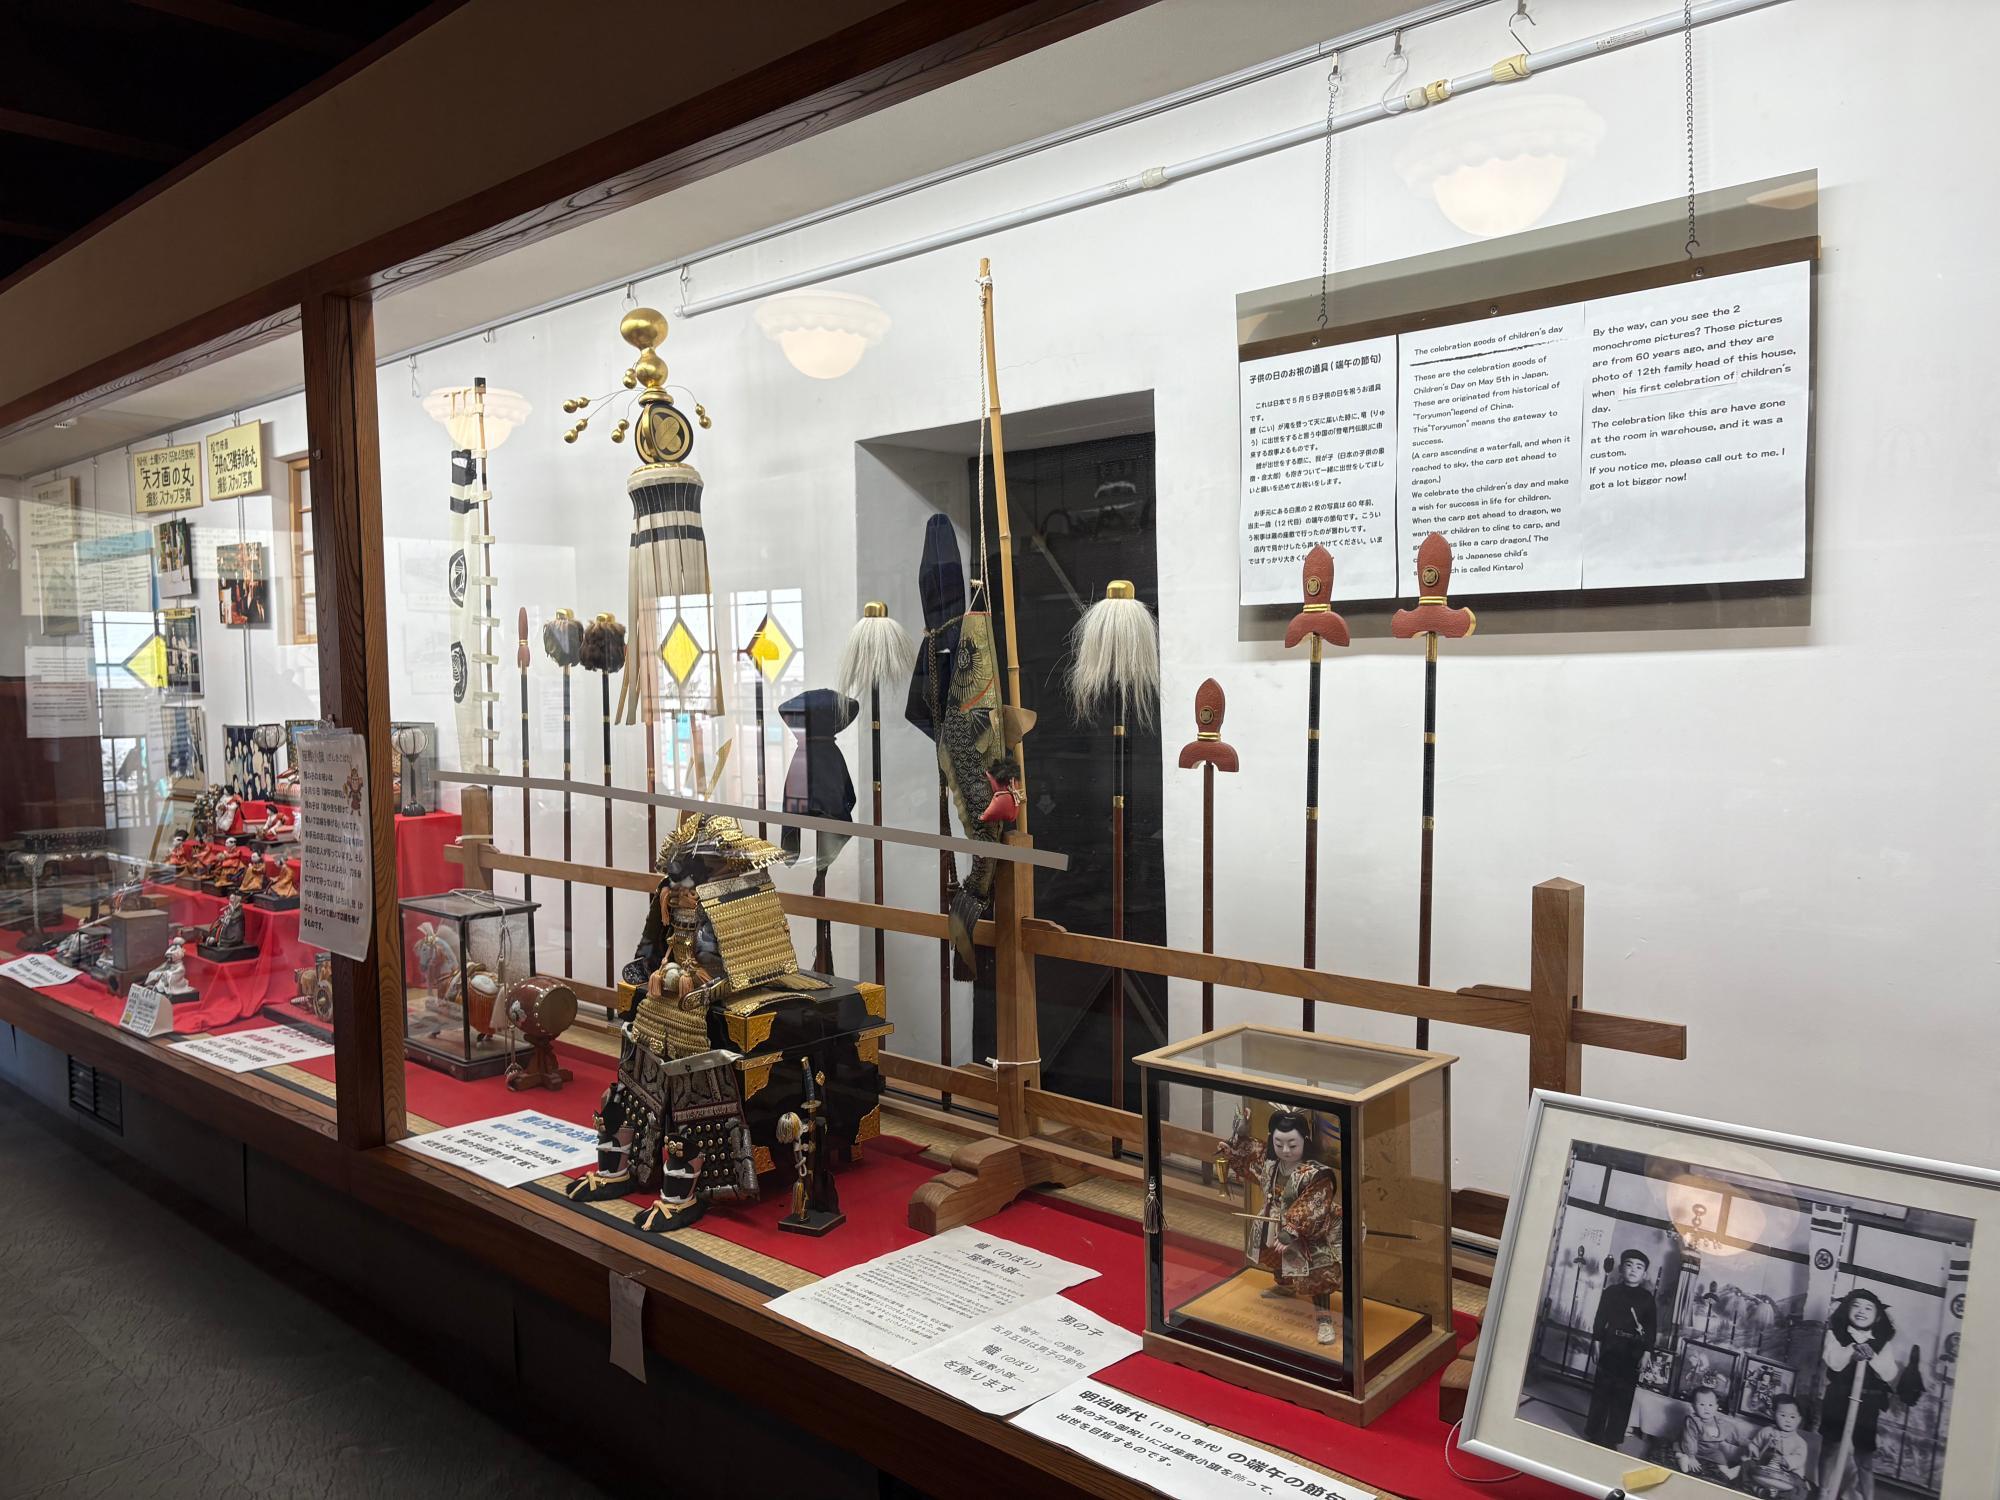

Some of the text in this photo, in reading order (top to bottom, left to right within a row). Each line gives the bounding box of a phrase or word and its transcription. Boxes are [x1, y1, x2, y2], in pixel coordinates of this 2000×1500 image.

[1592, 304, 1740, 336] By the way, can you see the 2
[1414, 348, 1428, 356] The
[1429, 341, 1471, 353] celebration
[1473, 336, 1496, 347] goods
[1497, 334, 1506, 342] of
[1548, 326, 1563, 334] day
[1592, 337, 1652, 352] monochrome
[1654, 326, 1701, 343] pictures?
[1738, 316, 1782, 330] pictures
[1592, 334, 1774, 368] are from 60 years ago, and they are
[1414, 374, 1436, 382] These
[1452, 368, 1466, 376] the
[1467, 362, 1510, 374] celebration
[1512, 357, 1536, 368] goods
[1537, 355, 1547, 363] of
[1592, 348, 1796, 384] photo of 12th family head of this house,
[1412, 400, 1436, 408] These
[1451, 391, 1490, 402] originated
[1511, 382, 1549, 394] historical
[1550, 380, 1560, 389] of
[1450, 382, 1465, 390] Day
[1478, 378, 1494, 386] May
[1496, 375, 1511, 383] 5th
[1521, 371, 1549, 380] Japan.
[1591, 389, 1615, 398] when
[1622, 386, 1637, 394] his
[1639, 383, 1661, 392] first
[1663, 375, 1720, 389] celebration
[1723, 371, 1735, 380] of
[1249, 414, 1264, 422] です。
[1471, 418, 1495, 426] means
[1497, 415, 1511, 423] the
[1512, 412, 1546, 422] gateway
[1479, 404, 1488, 412] of
[1490, 402, 1514, 411] China.
[1591, 405, 1611, 414] day.
[1591, 400, 1786, 429] The celebration like this are have gone
[1412, 438, 1444, 446] success.
[1590, 436, 1601, 444] at
[1604, 434, 1620, 442] the
[1622, 432, 1647, 440] room
[1649, 429, 1658, 438] in
[1660, 425, 1716, 436] warehouse,
[1719, 419, 1738, 430] and
[1741, 419, 1750, 427] it
[1752, 418, 1773, 426] was
[1440, 446, 1478, 456] ascending
[1486, 440, 1522, 451] waterfall,
[1524, 438, 1539, 447] and
[1541, 437, 1562, 445] when
[1564, 435, 1570, 443] it
[1590, 450, 1627, 459] custom.
[1589, 466, 1596, 475] If
[1598, 466, 1616, 474] you
[1618, 462, 1648, 472] notice
[1669, 458, 1702, 467] please
[1704, 453, 1722, 463] call
[1724, 452, 1742, 461] out
[1745, 451, 1758, 459] to
[1760, 450, 1779, 458] me.
[1782, 447, 1785, 456] I
[140, 463, 194, 490] 「天才画の女」
[1589, 481, 1605, 490] got
[1616, 479, 1630, 487] lot
[1632, 477, 1663, 486] bigger
[1664, 472, 1687, 483] now!
[1058, 1315, 1104, 1336] 男の子
[944, 1360, 1016, 1392] を飾ります
[1056, 1414, 1171, 1466] 出世を目指すものです。
